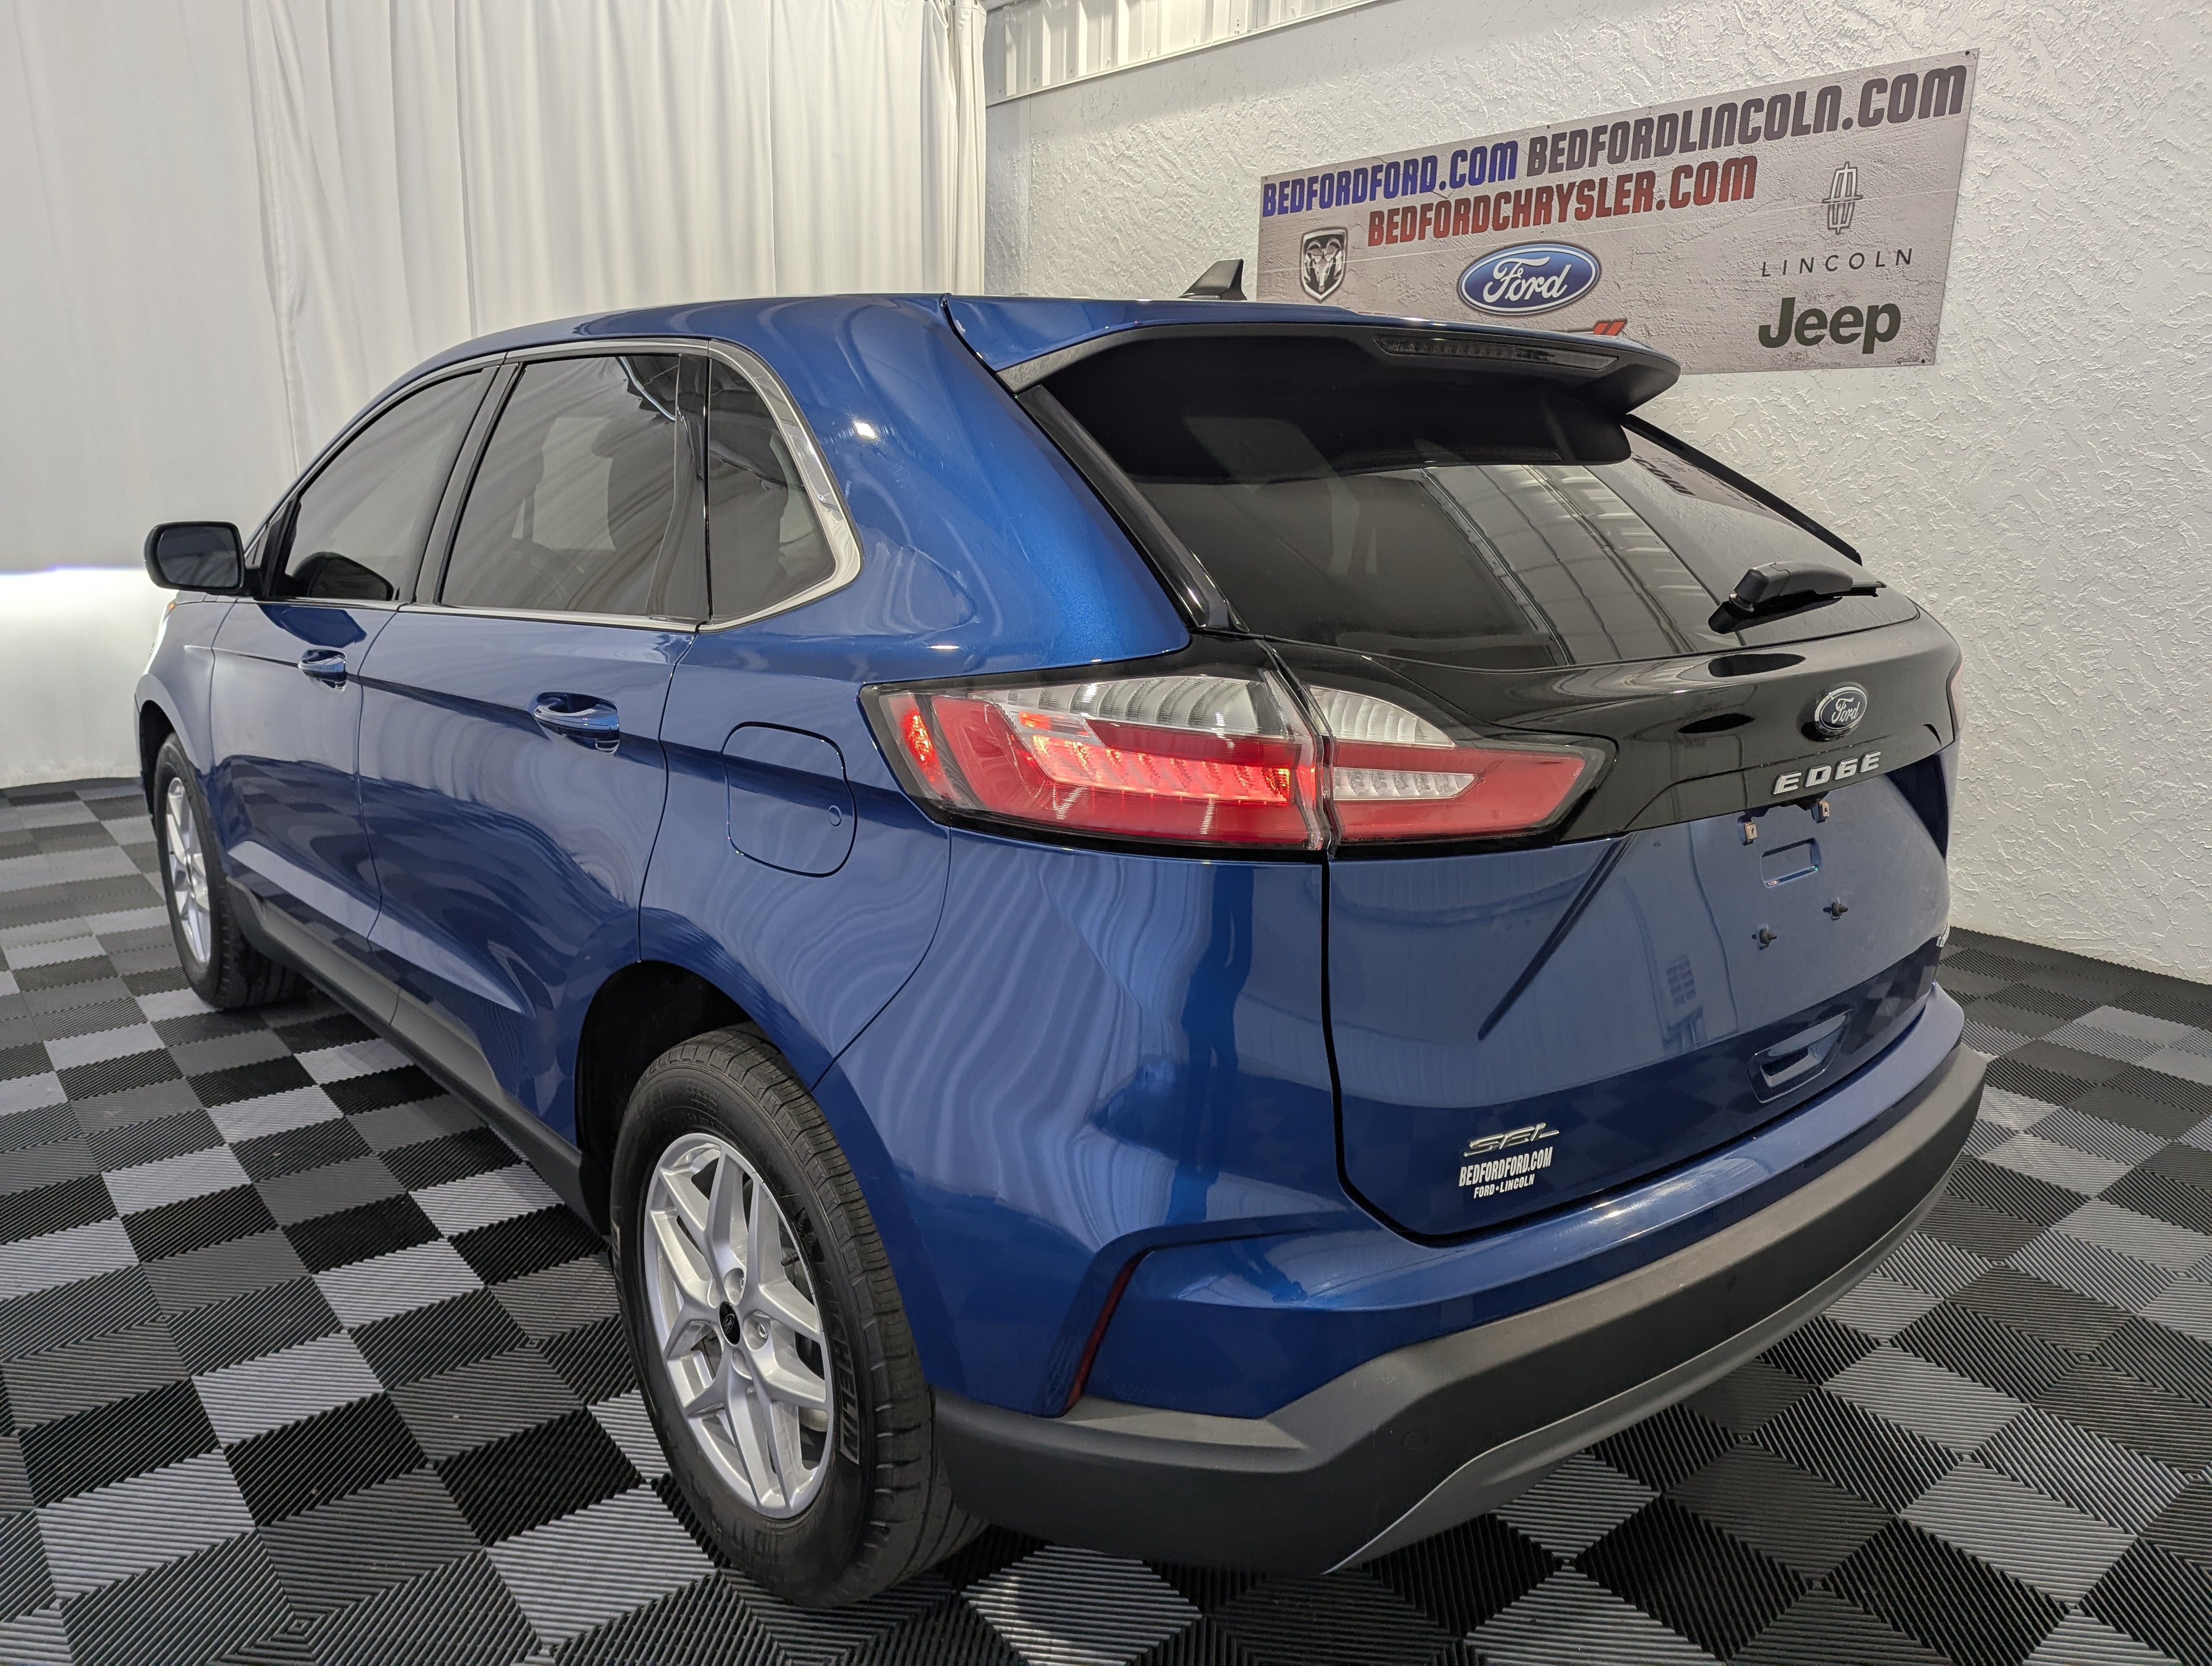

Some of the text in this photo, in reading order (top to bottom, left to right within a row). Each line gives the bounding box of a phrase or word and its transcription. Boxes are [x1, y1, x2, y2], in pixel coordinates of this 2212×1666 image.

[1262, 65, 1967, 217] BEDFORDFORD.COM BEDFORDLINCOLN.COM
[1368, 155, 1758, 247] BEDFORDCHRYSLER.COM
[1483, 256, 1572, 303] Ford
[1762, 248, 1912, 277] LINCOLN
[1759, 297, 1901, 354] Jeep
[1831, 697, 1860, 724] Ford
[1773, 751, 1881, 794] EDGE
[1463, 1123, 1560, 1157] SEL
[1458, 1146, 1553, 1187] BEDFORDFORD.COM
